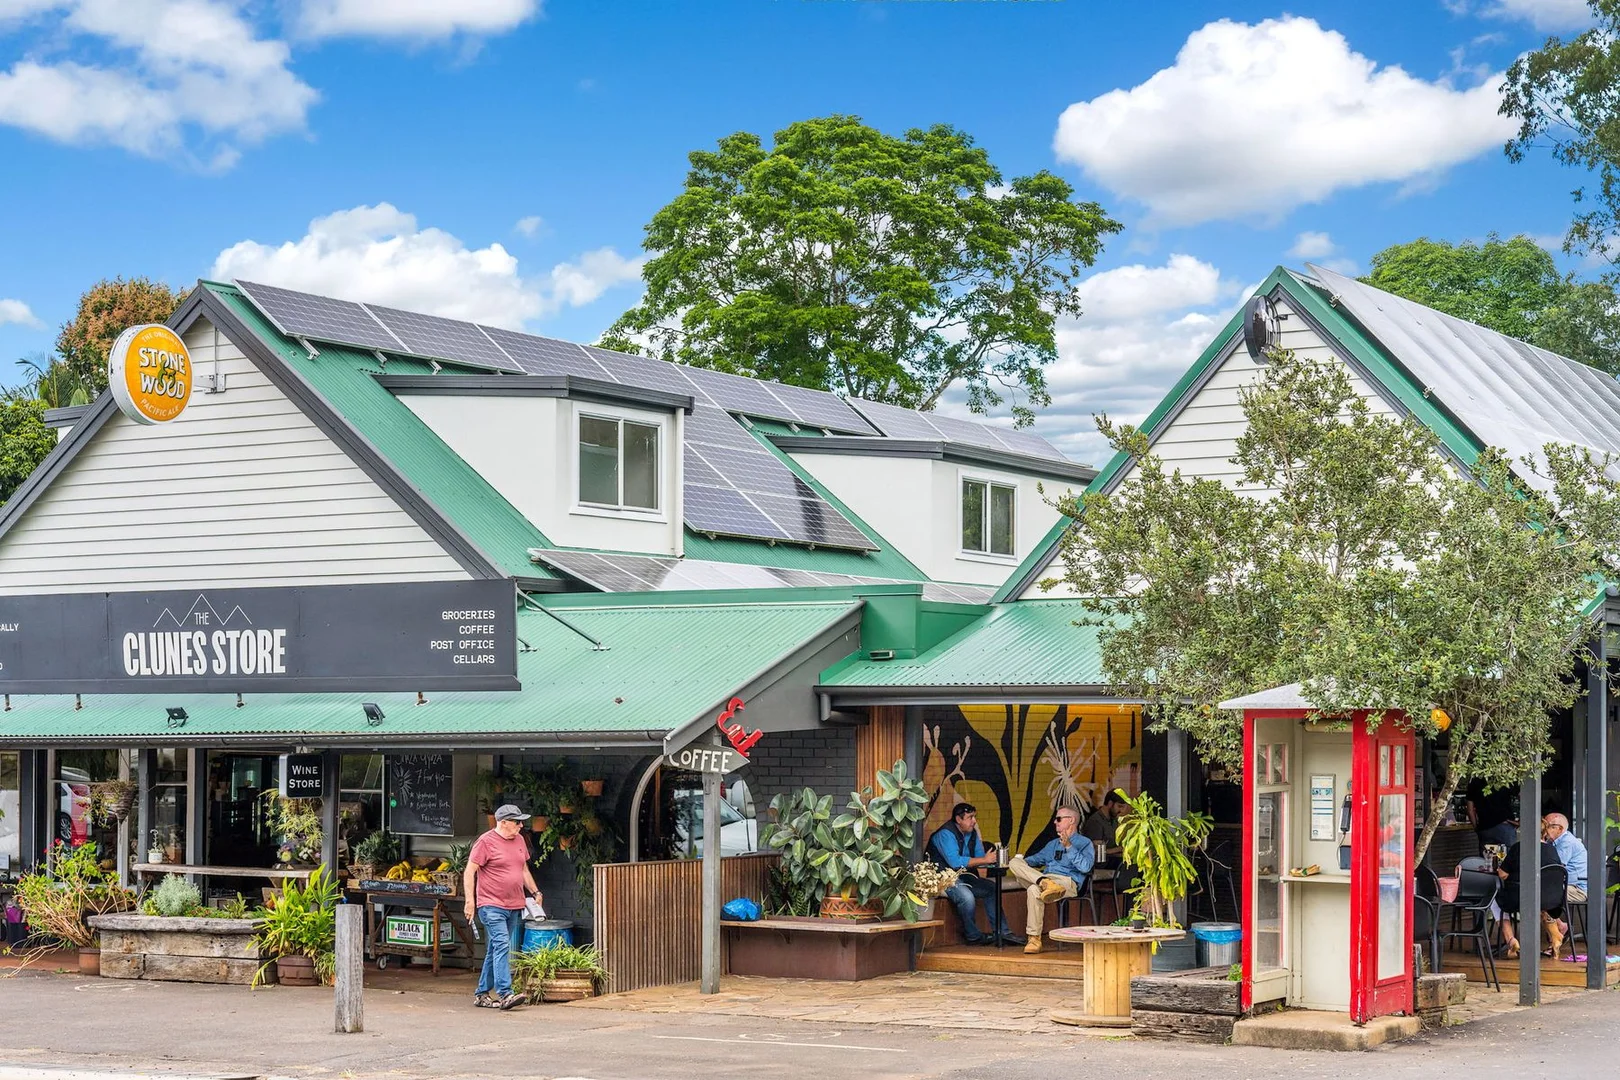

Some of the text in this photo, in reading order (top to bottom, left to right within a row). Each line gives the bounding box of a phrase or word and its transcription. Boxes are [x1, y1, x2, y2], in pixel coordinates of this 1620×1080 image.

[141, 333, 153, 343] THE
[139, 347, 186, 375] STONE
[140, 372, 185, 399] WOOD
[140, 398, 180, 417] PACIFIC ALE
[194, 612, 209, 625] THE
[441, 609, 496, 620] GROCERIES
[0, 622, 19, 632] ALLY
[459, 624, 495, 634] COFFEE
[430, 639, 495, 650] POST OFFICE
[122, 628, 287, 677] CLUNES STORE
[453, 654, 495, 664] CELLARS
